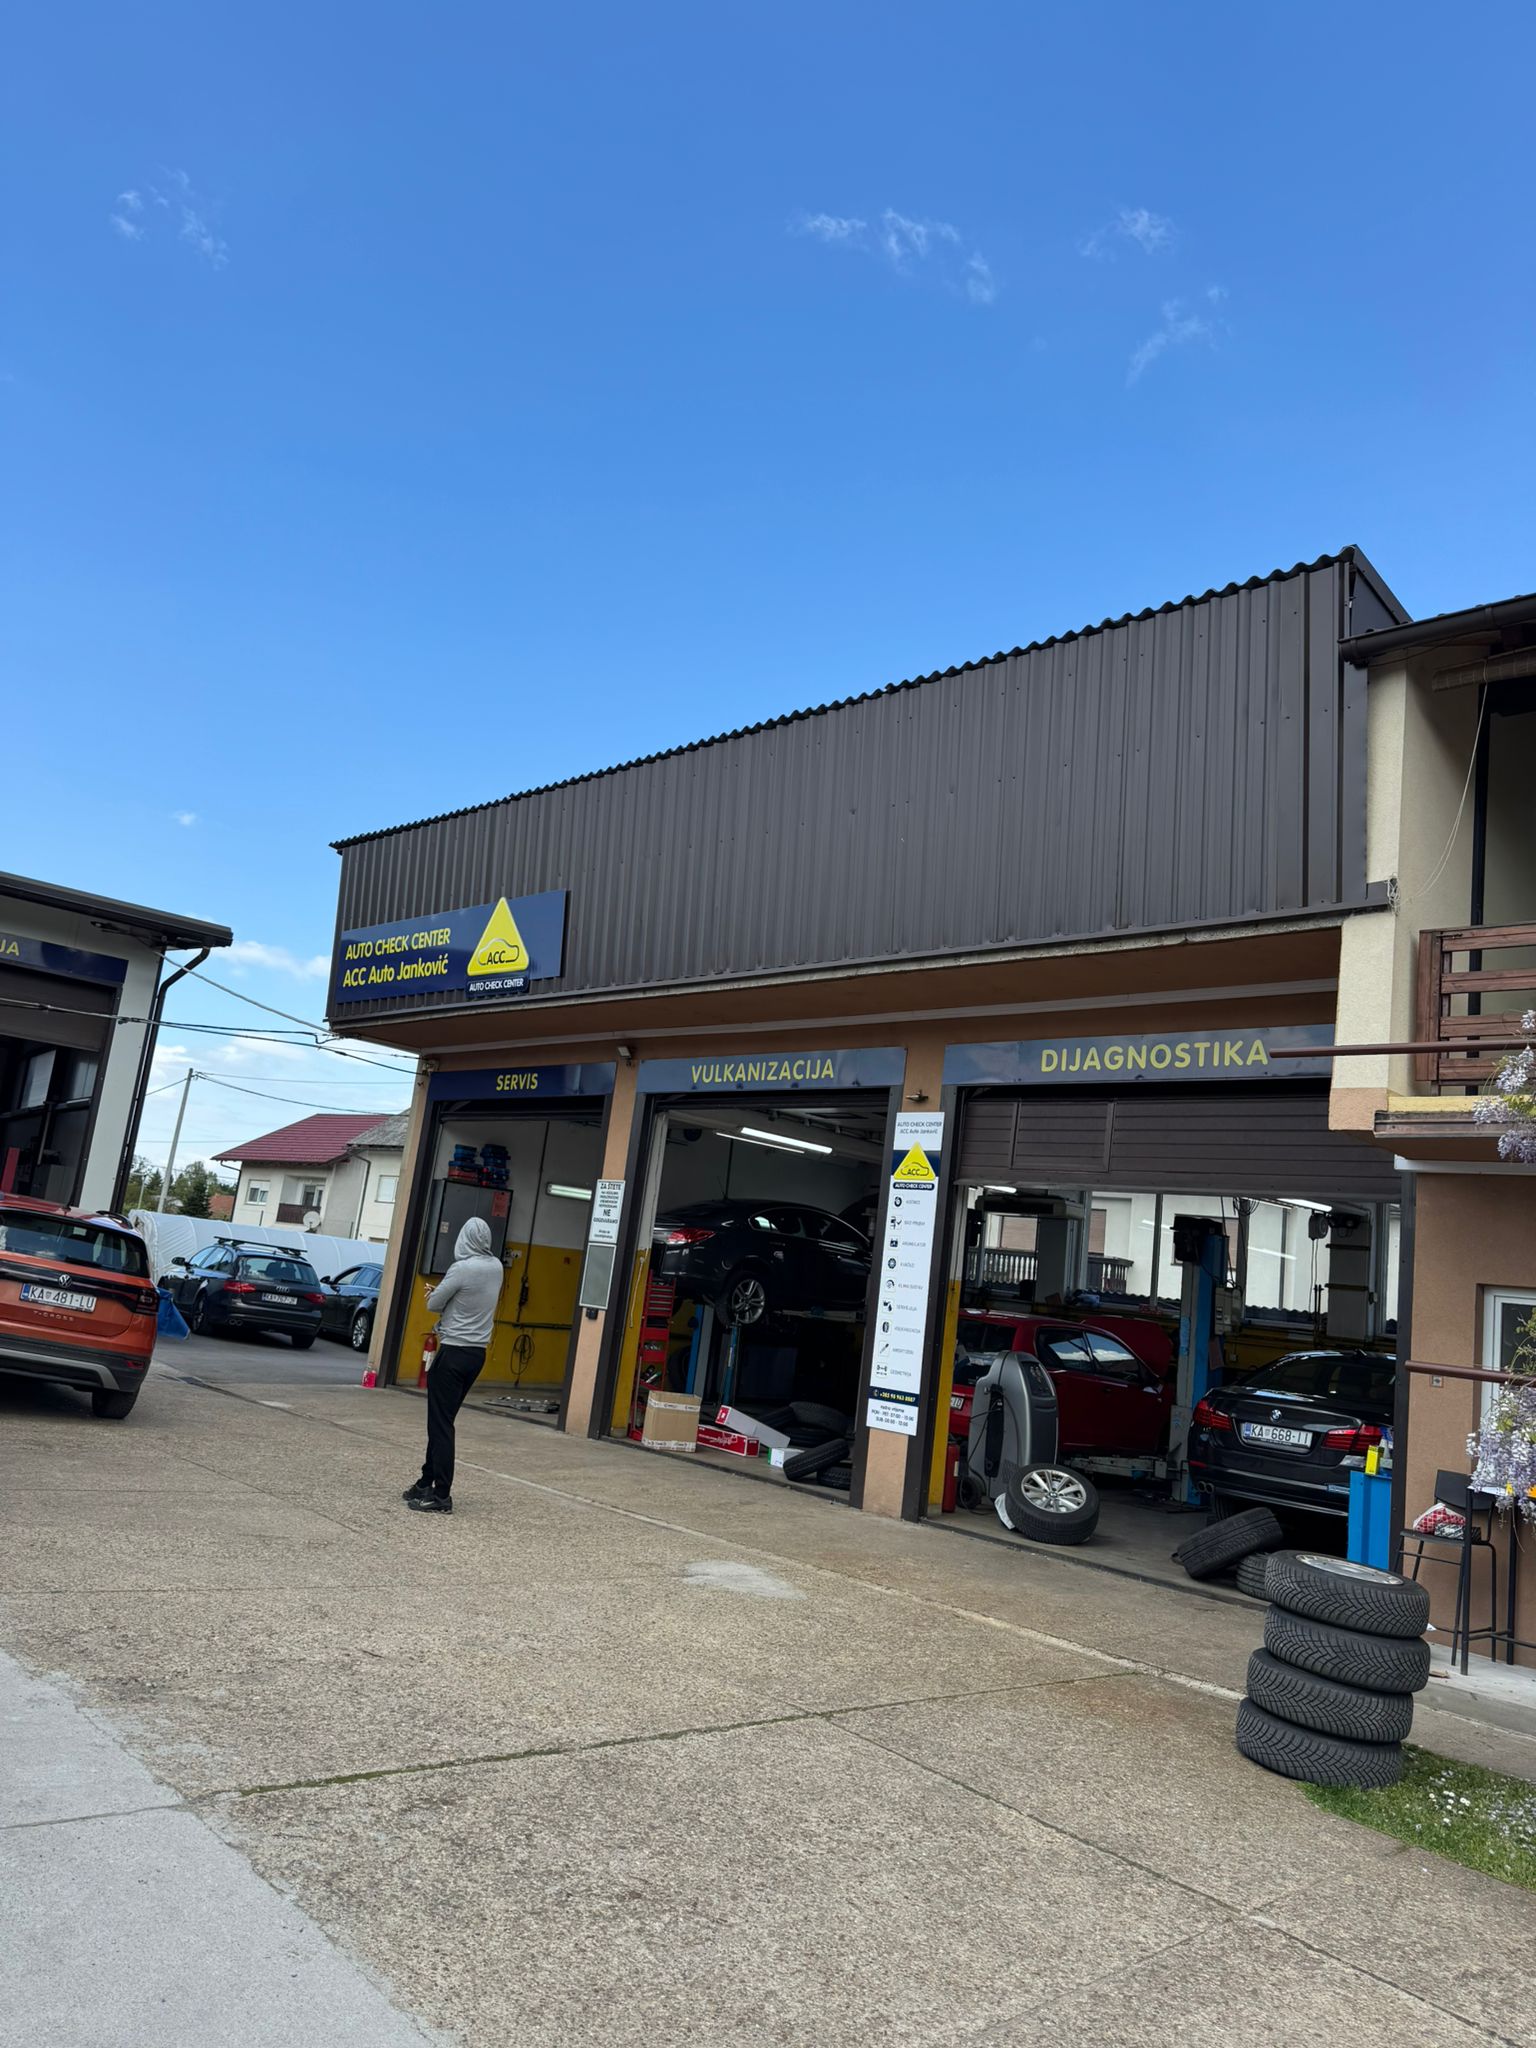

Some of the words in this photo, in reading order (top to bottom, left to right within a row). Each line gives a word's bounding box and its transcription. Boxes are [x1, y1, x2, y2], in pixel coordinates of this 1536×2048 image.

[345, 941, 373, 960] AUTO
[375, 934, 410, 956] CHECK
[411, 928, 451, 950] CENTER
[487, 950, 506, 965] ACC
[343, 966, 366, 988] ACC
[368, 964, 395, 984] Auto
[397, 953, 449, 981] Janković
[469, 981, 484, 992] AUTO
[485, 980, 502, 990] CHECK
[503, 978, 524, 988] CENTER
[1041, 1040, 1269, 1072] DIJAGNOSTIKA
[691, 1058, 834, 1084] VULKANIZACIJA
[496, 1073, 538, 1091] SERVIS
[907, 1168, 920, 1176] ACC
[600, 1182, 607, 1190] ZA
[603, 1209, 611, 1217] NE
[30, 1287, 44, 1299] KA
[53, 1291, 95, 1309] 481-LU
[1251, 1424, 1264, 1437] KA
